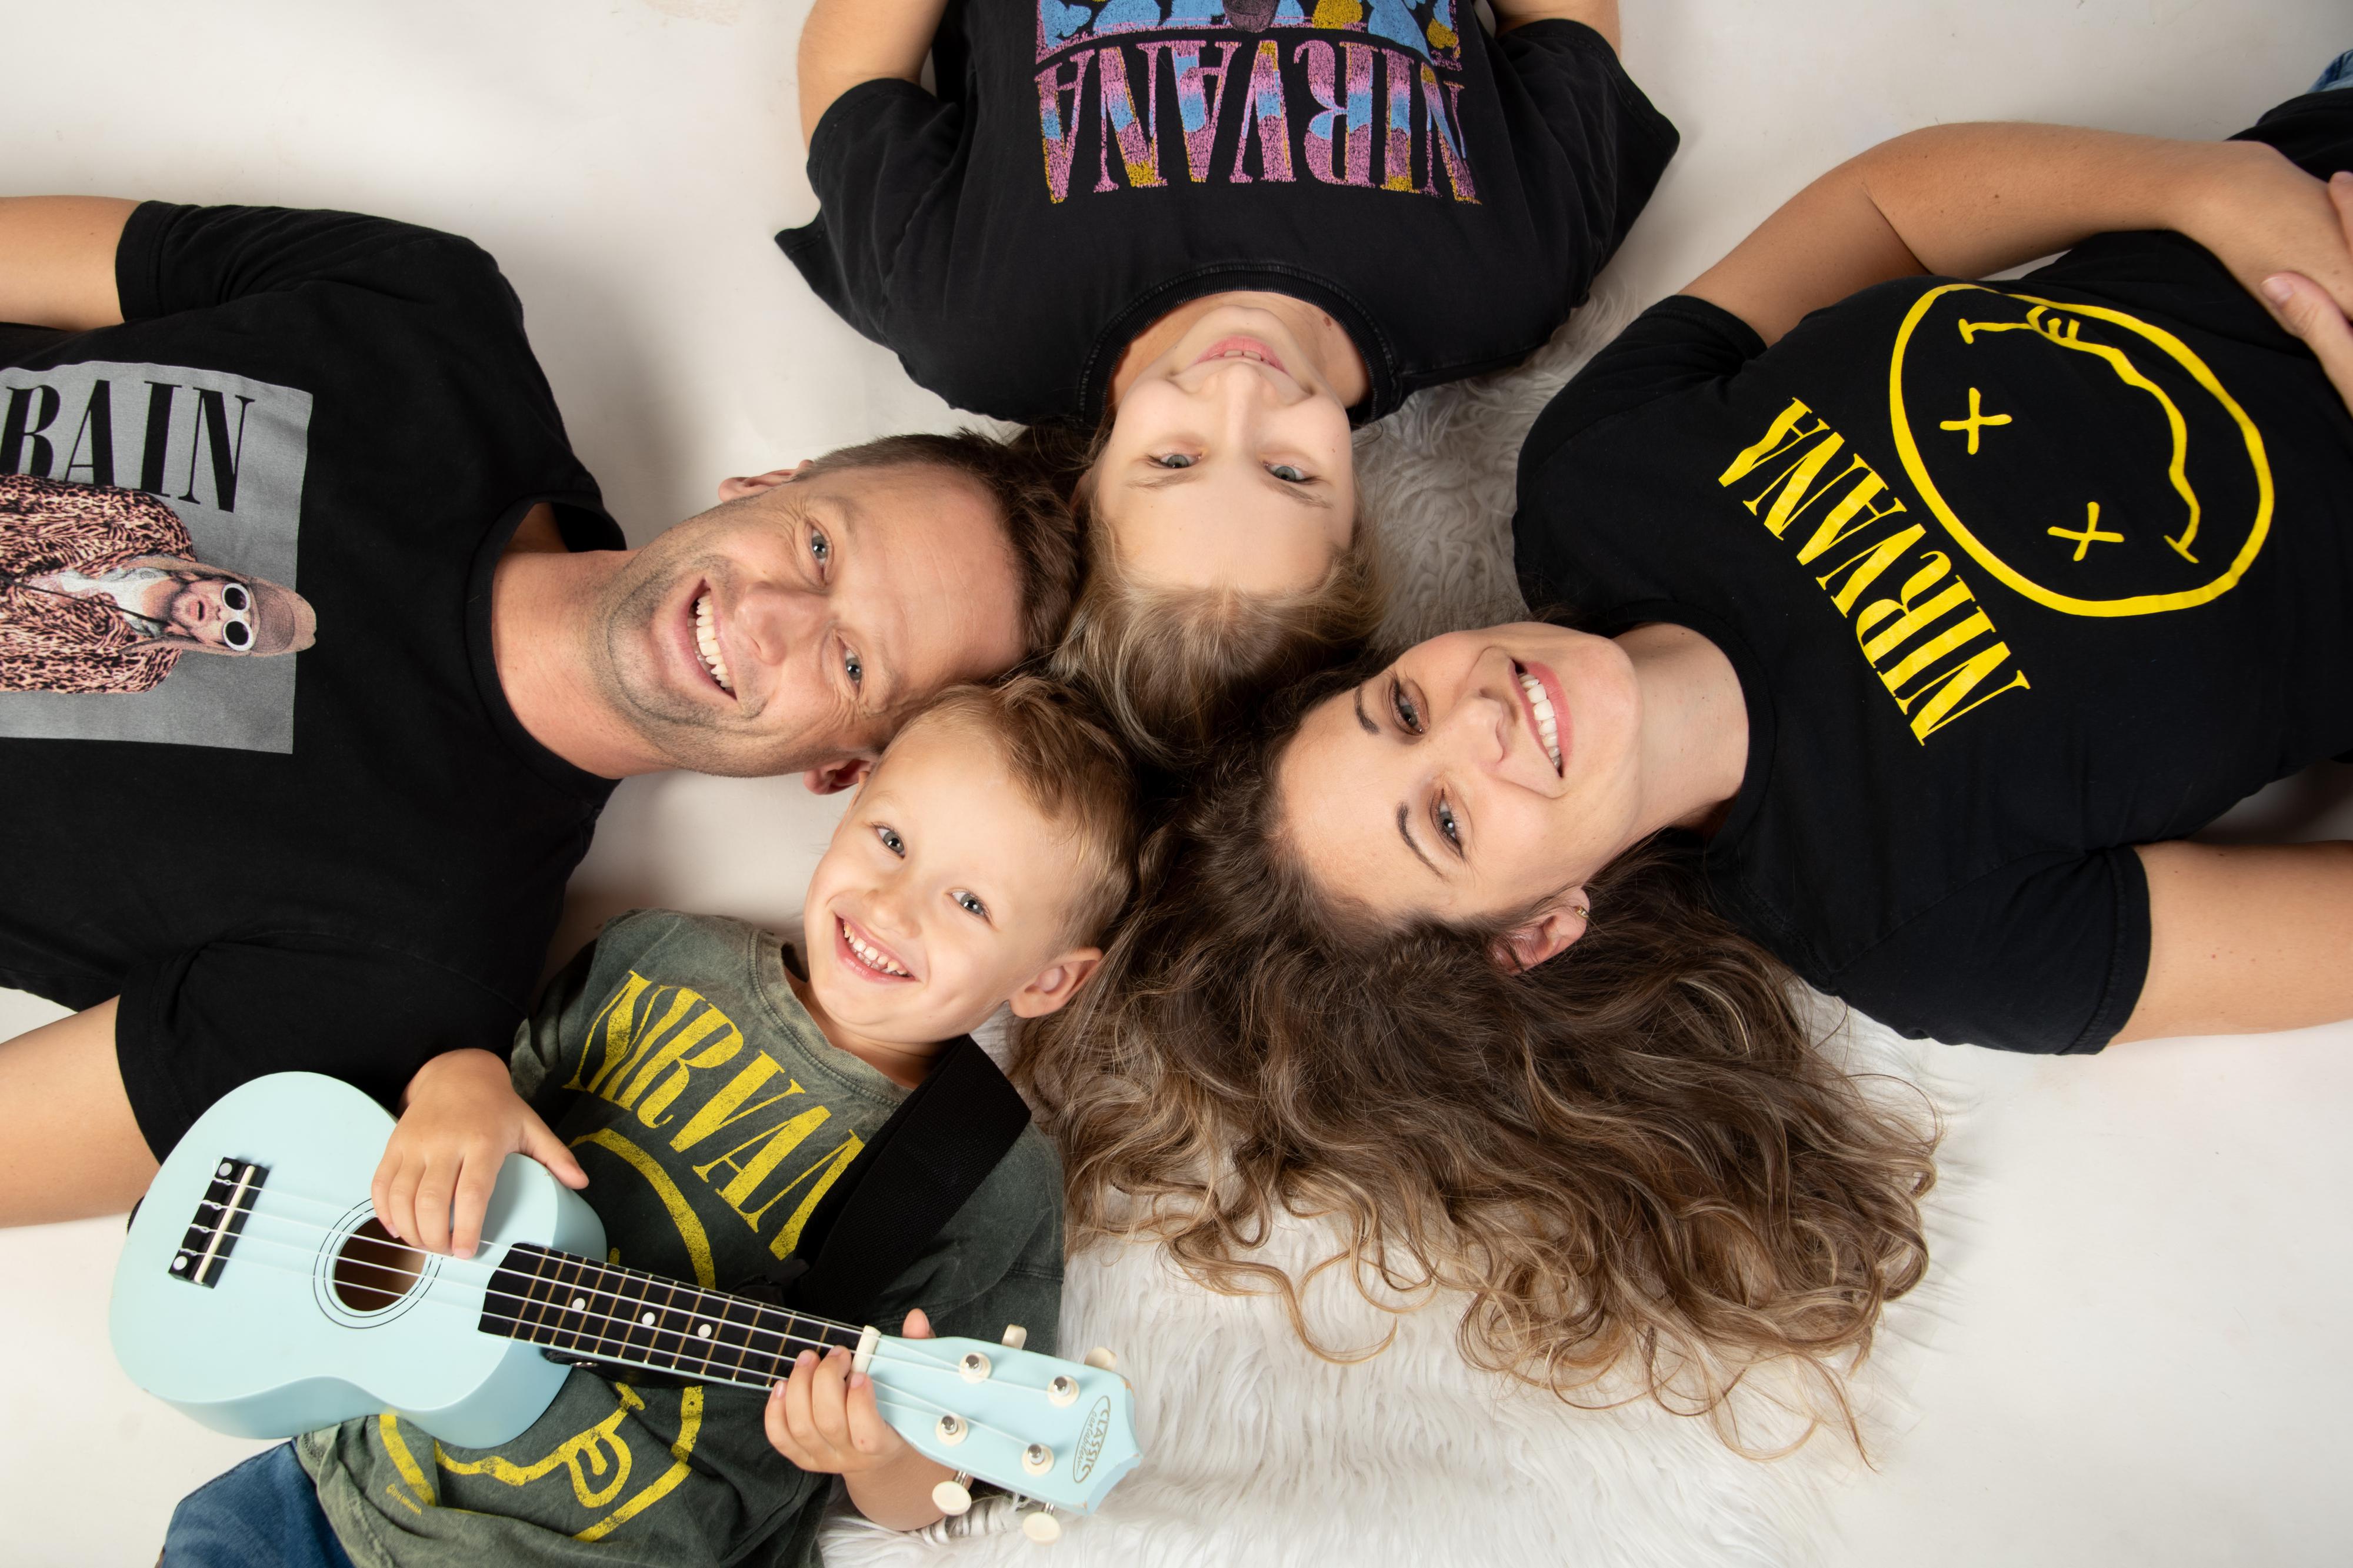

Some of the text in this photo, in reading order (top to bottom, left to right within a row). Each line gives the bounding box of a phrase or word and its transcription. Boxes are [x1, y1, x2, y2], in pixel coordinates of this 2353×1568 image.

[1034, 39, 1482, 205] NIRVANA
[0, 379, 255, 513] BAIN
[1718, 397, 2031, 746] NIRVANA
[1082, 1409, 1109, 1472] CLASSIC
